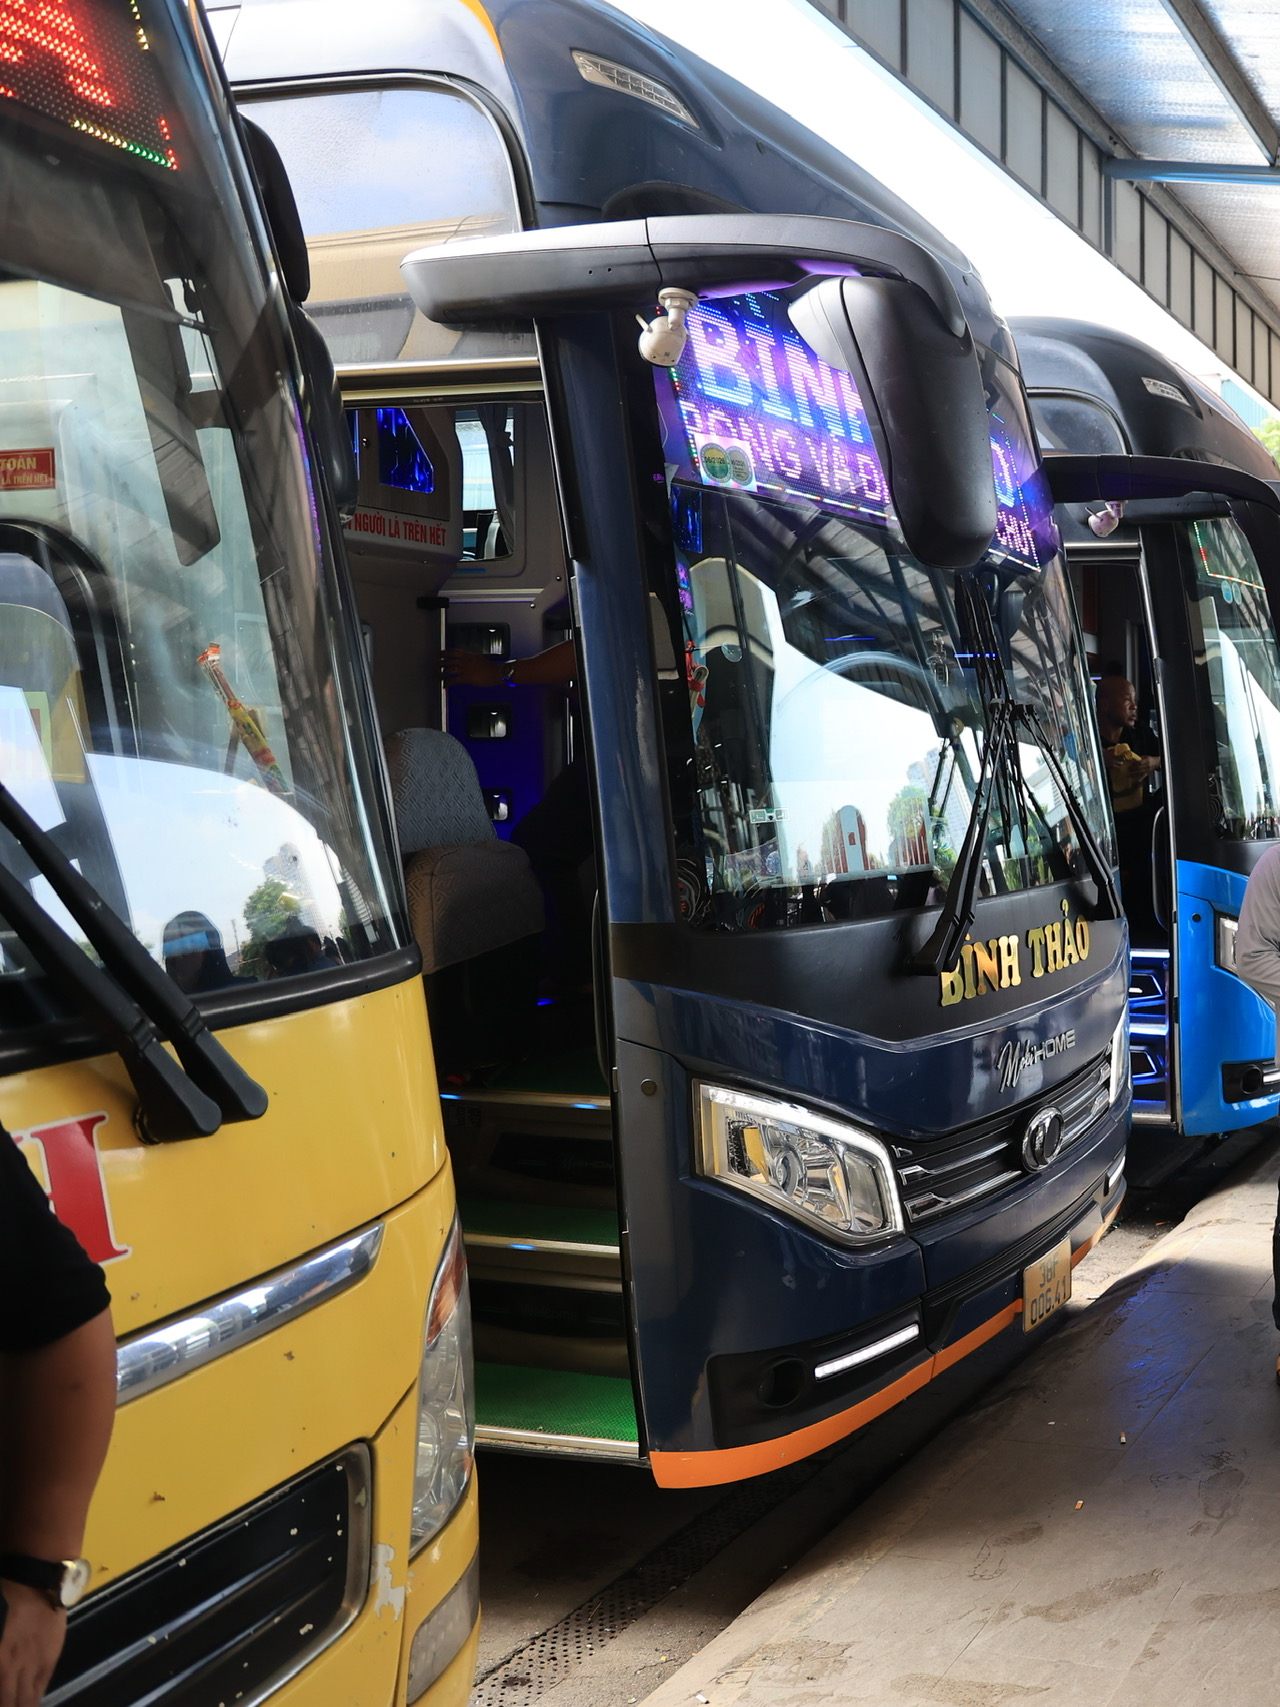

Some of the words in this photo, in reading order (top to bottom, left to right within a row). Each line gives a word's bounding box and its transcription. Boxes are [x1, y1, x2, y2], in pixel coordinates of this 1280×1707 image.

[856, 452, 891, 504] Đ
[353, 511, 386, 536] NGƯỜI
[388, 515, 401, 539] LÀ
[403, 520, 427, 543] TRÊN
[429, 523, 447, 546] HẾT
[1027, 898, 1090, 978] THẢO
[1030, 1275, 1067, 1326] 006.41
